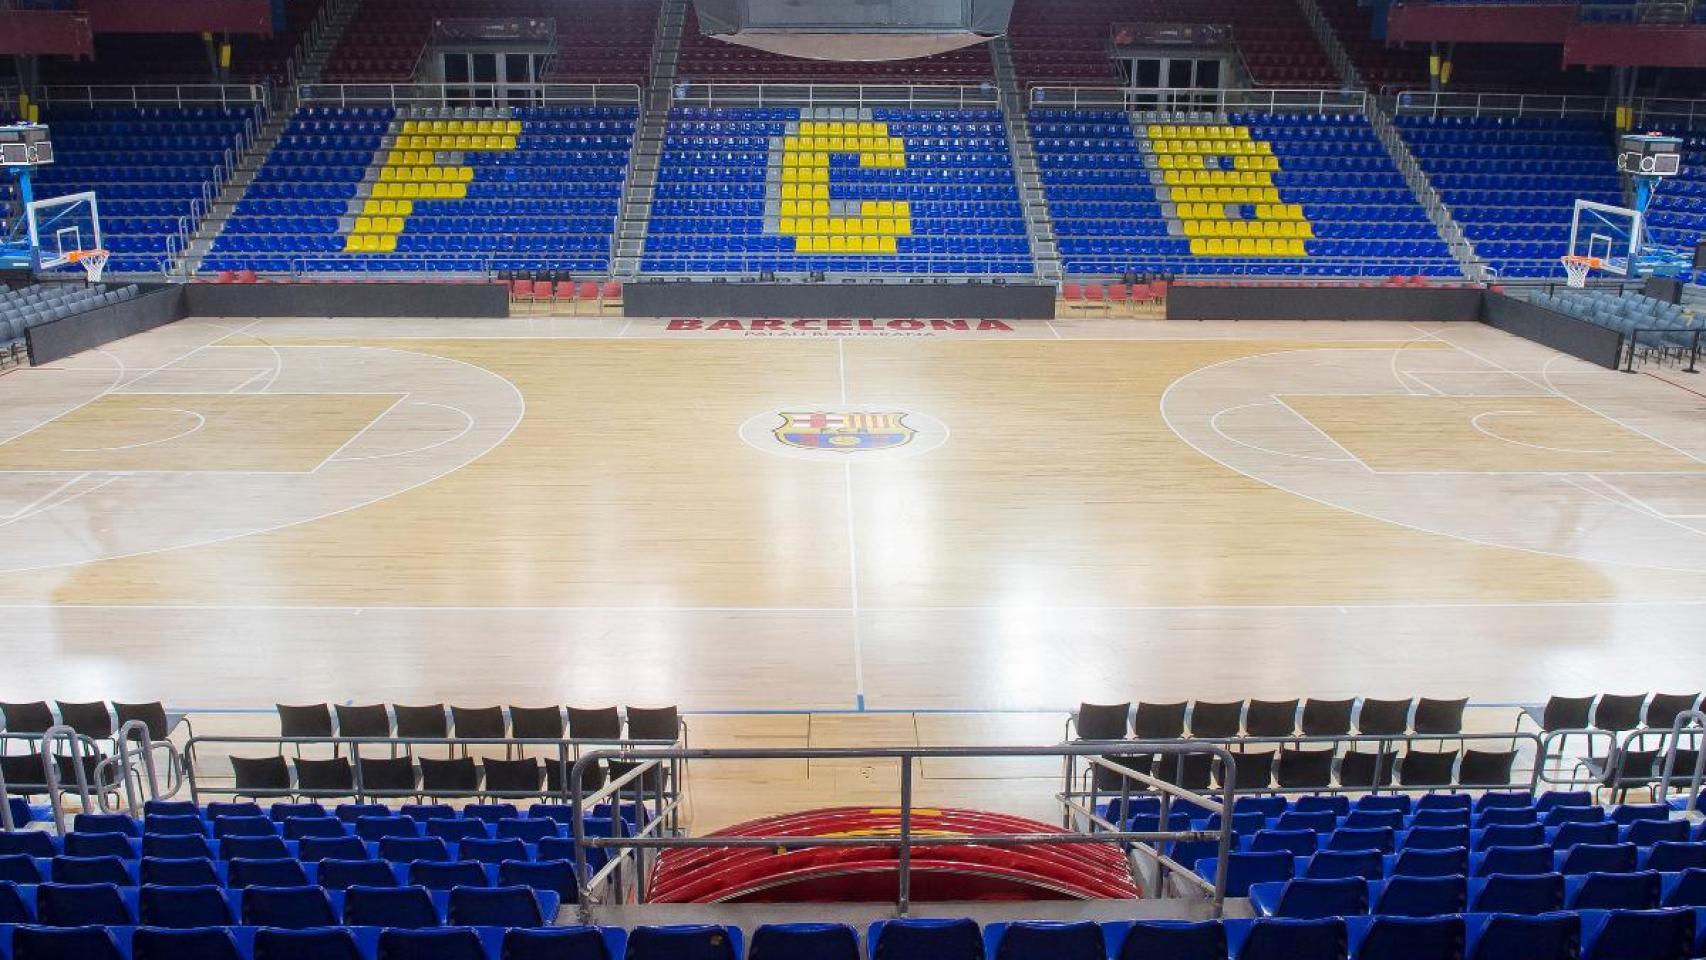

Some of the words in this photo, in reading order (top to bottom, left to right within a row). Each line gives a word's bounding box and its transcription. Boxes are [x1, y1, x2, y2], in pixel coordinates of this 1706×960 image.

[344, 120, 522, 253] F
[779, 120, 912, 253] C
[1148, 125, 1316, 257] B
[666, 319, 1014, 330] BARCELONA
